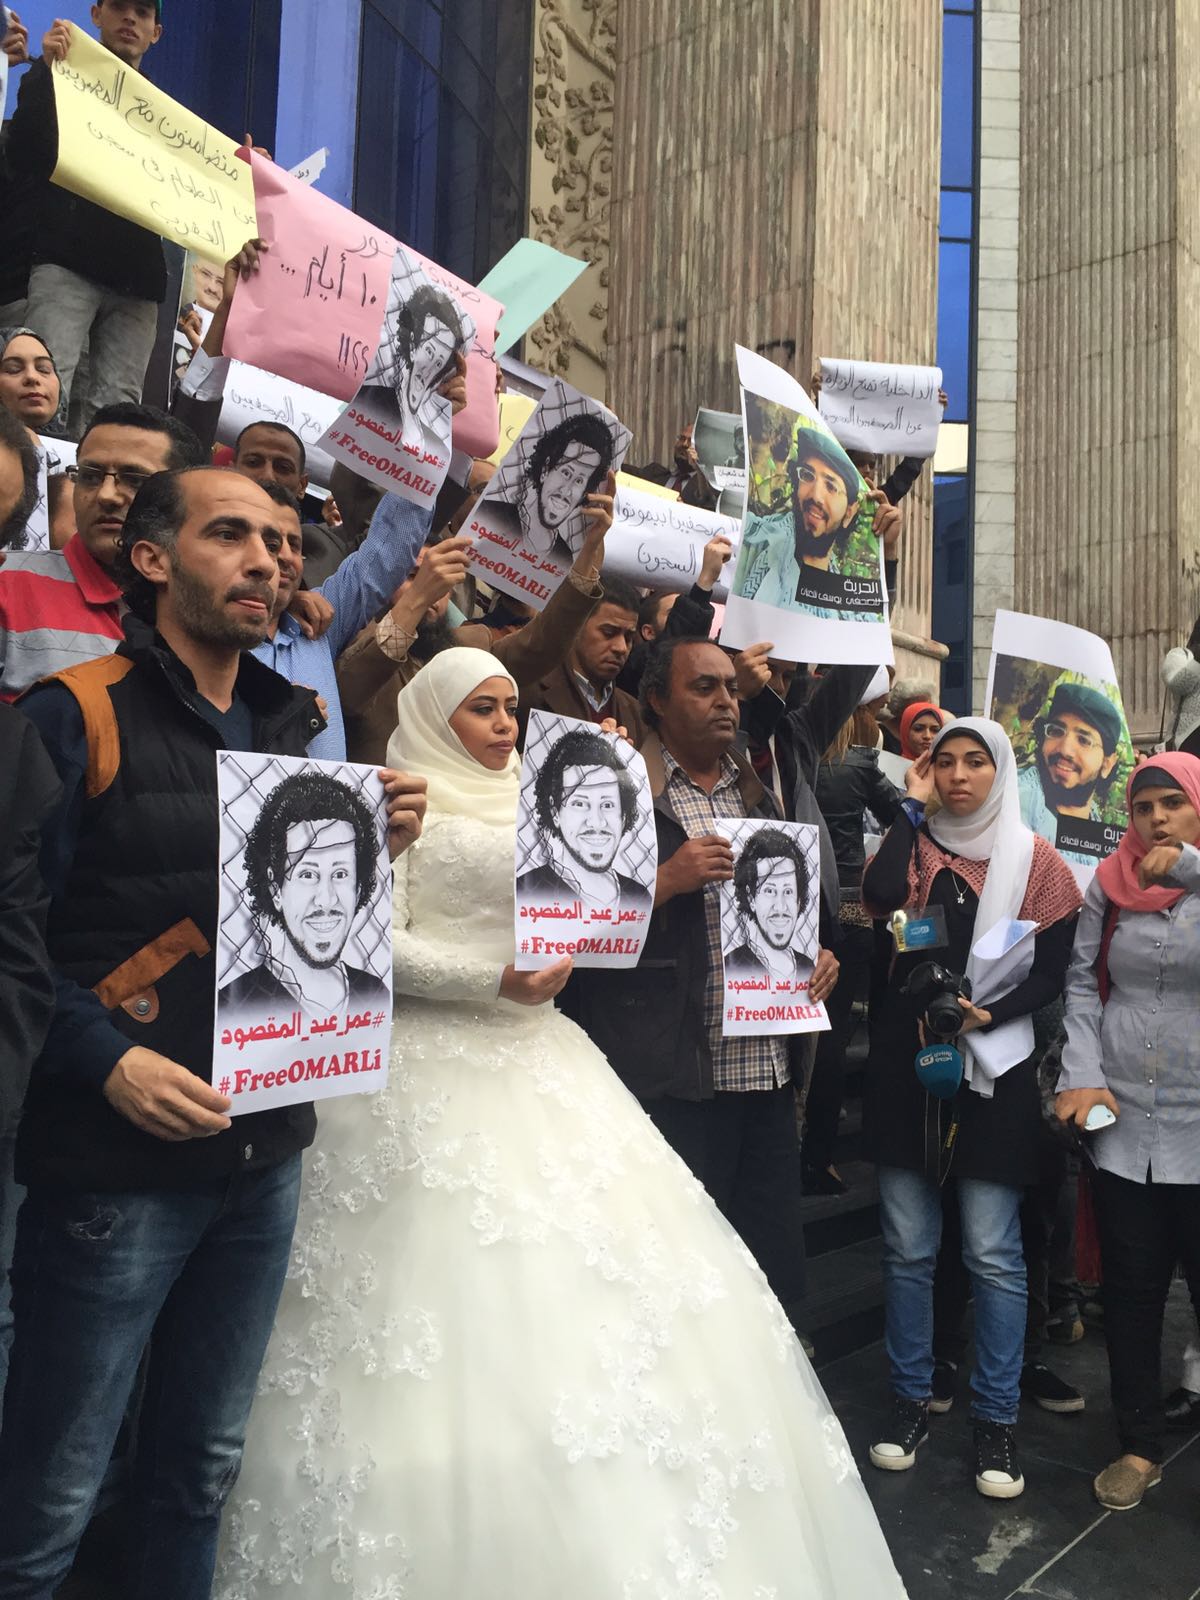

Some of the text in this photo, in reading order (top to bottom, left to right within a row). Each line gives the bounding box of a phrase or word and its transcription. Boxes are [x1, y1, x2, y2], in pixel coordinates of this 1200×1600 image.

[125, 95, 154, 137] مع
[170, 167, 222, 209] الطعام
[303, 244, 347, 301] أيام
[905, 421, 922, 435] عن
[328, 429, 438, 497] #FreeOMARLi
[466, 546, 552, 601] FreeOMARLi
[637, 542, 697, 576] السجون
[843, 578, 879, 595] الحرية
[520, 900, 647, 925] #عمر_عبد_المقصود
[520, 936, 640, 956] #FreeOMARLi
[727, 975, 811, 995] عمر_عبد_المقصود
[220, 1010, 386, 1051] #عمر_عبد_المقصود
[727, 1004, 823, 1022] #FreeOMARLi
[218, 1048, 382, 1097] #FreeOMARLi
